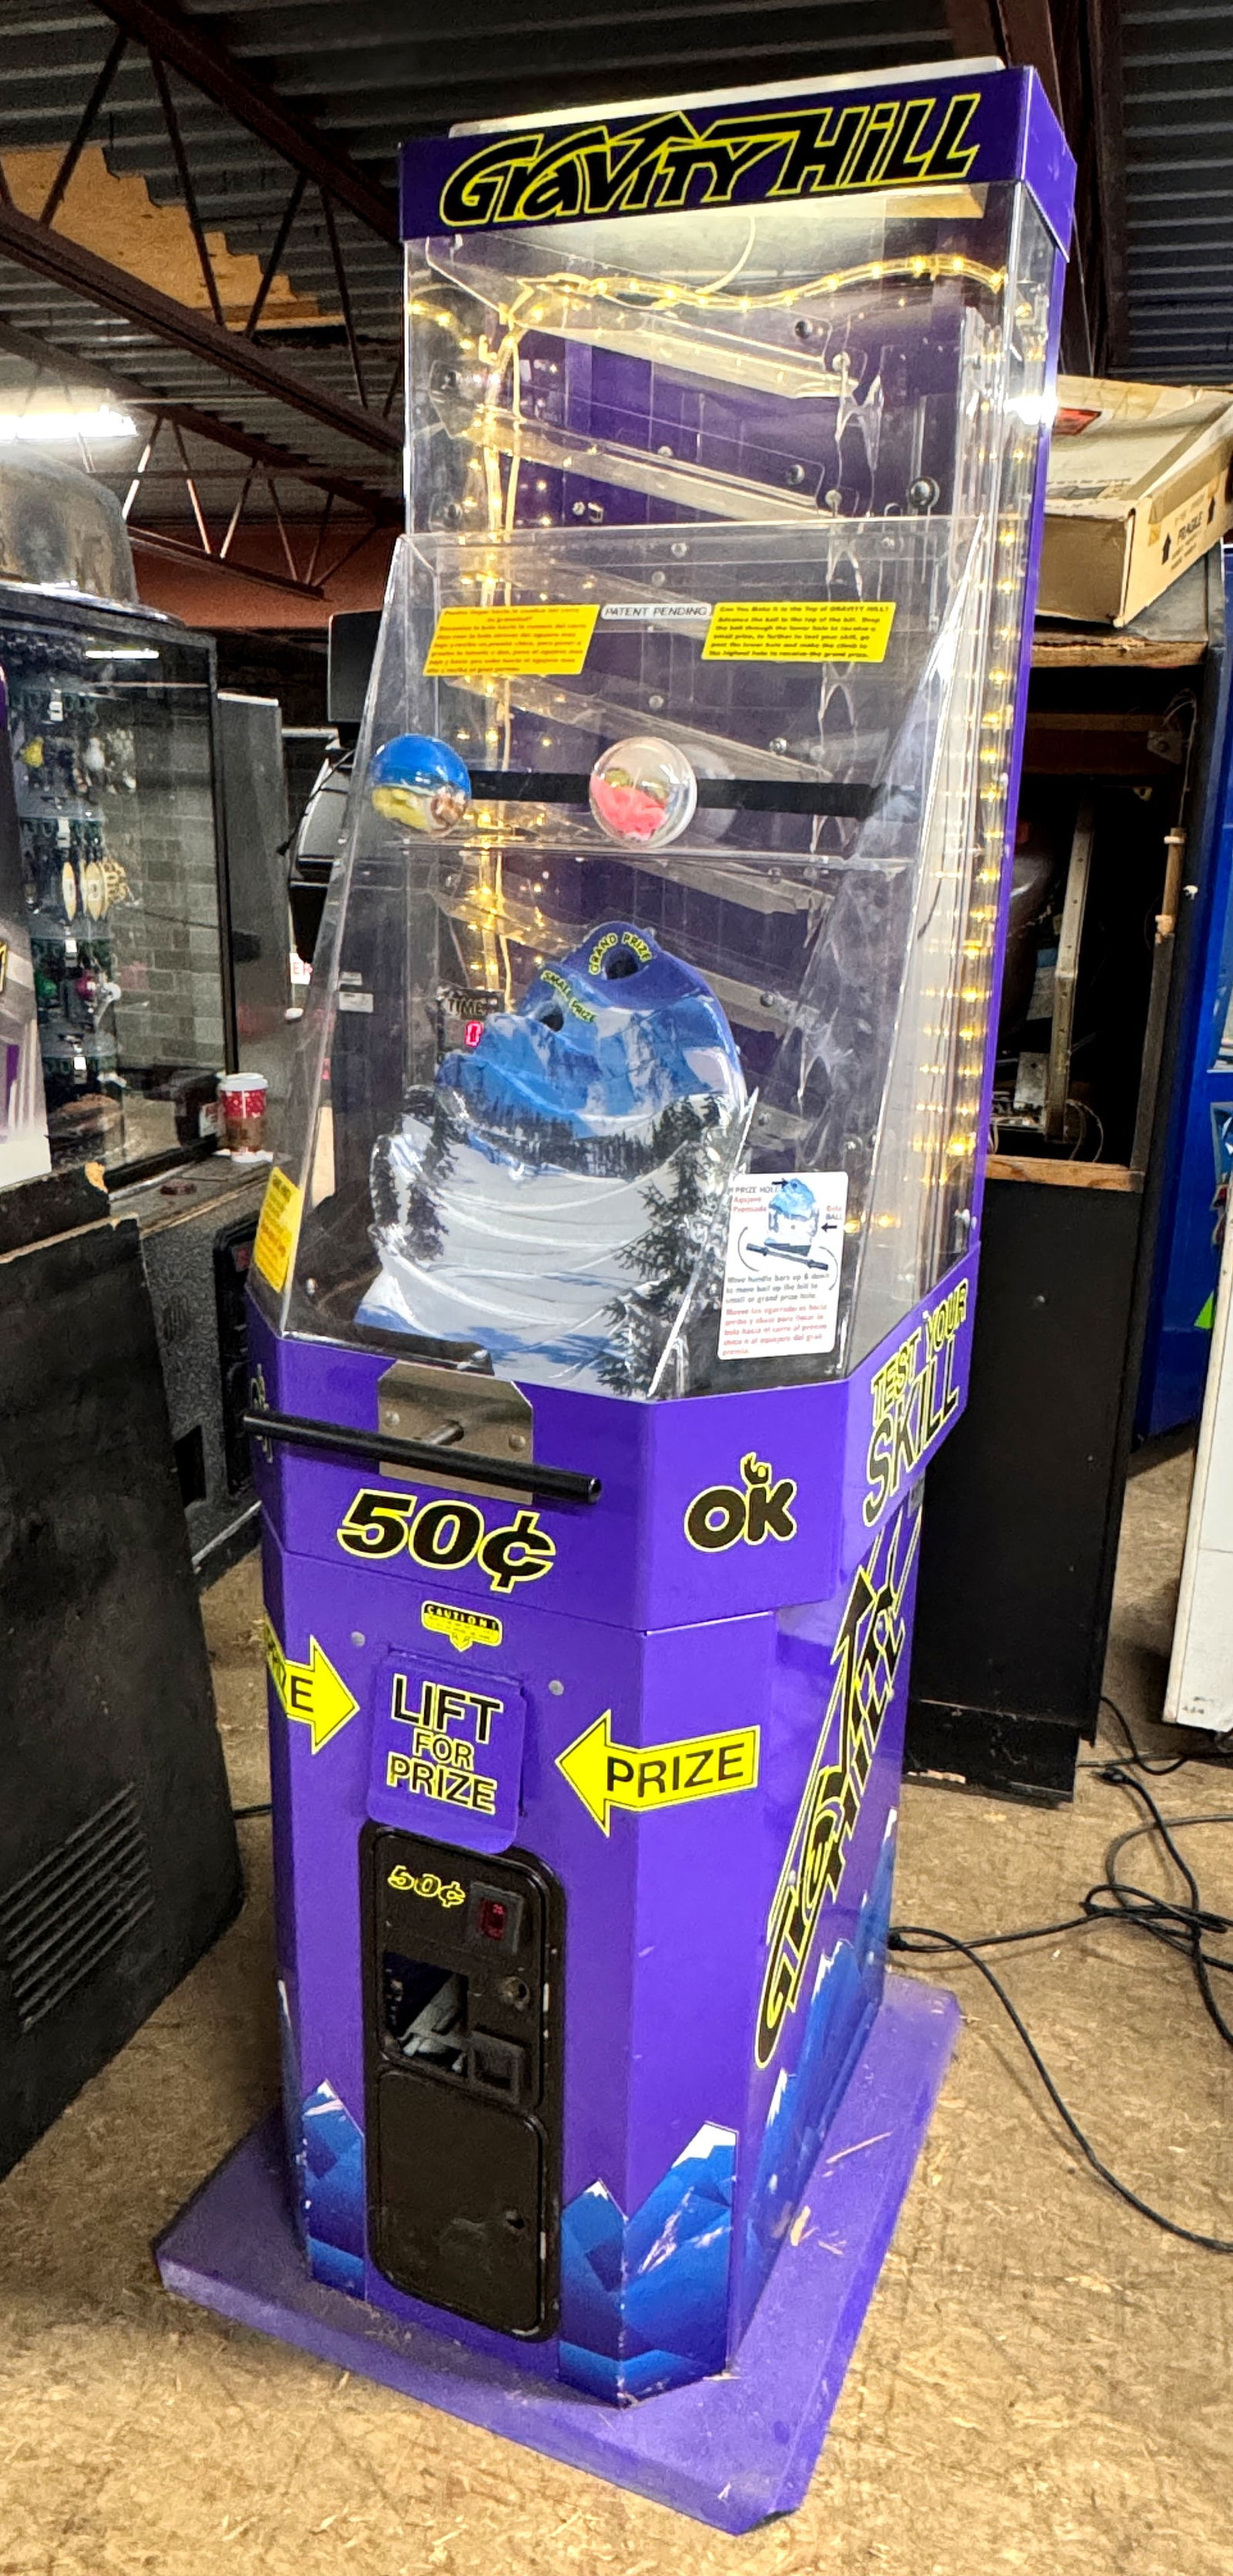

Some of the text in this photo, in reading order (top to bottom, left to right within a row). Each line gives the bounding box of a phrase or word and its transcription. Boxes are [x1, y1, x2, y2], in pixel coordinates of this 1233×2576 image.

[606, 607, 707, 616] PATENT PENDING
[589, 931, 653, 976] GRAND PRIZE
[448, 998, 483, 1015] TIME
[871, 1277, 969, 1427] TEST YOUR
[862, 1335, 959, 1528] SKILL
[337, 1488, 556, 1592] 50¢
[684, 1478, 797, 1552] OK
[426, 1605, 497, 1630] CAUTION!
[391, 1673, 503, 1744] LIFT
[412, 1727, 475, 1771] FOR
[606, 1742, 744, 1797] PRIZE
[387, 1751, 497, 1814] PRIZE
[388, 1864, 465, 1908] 50¢
